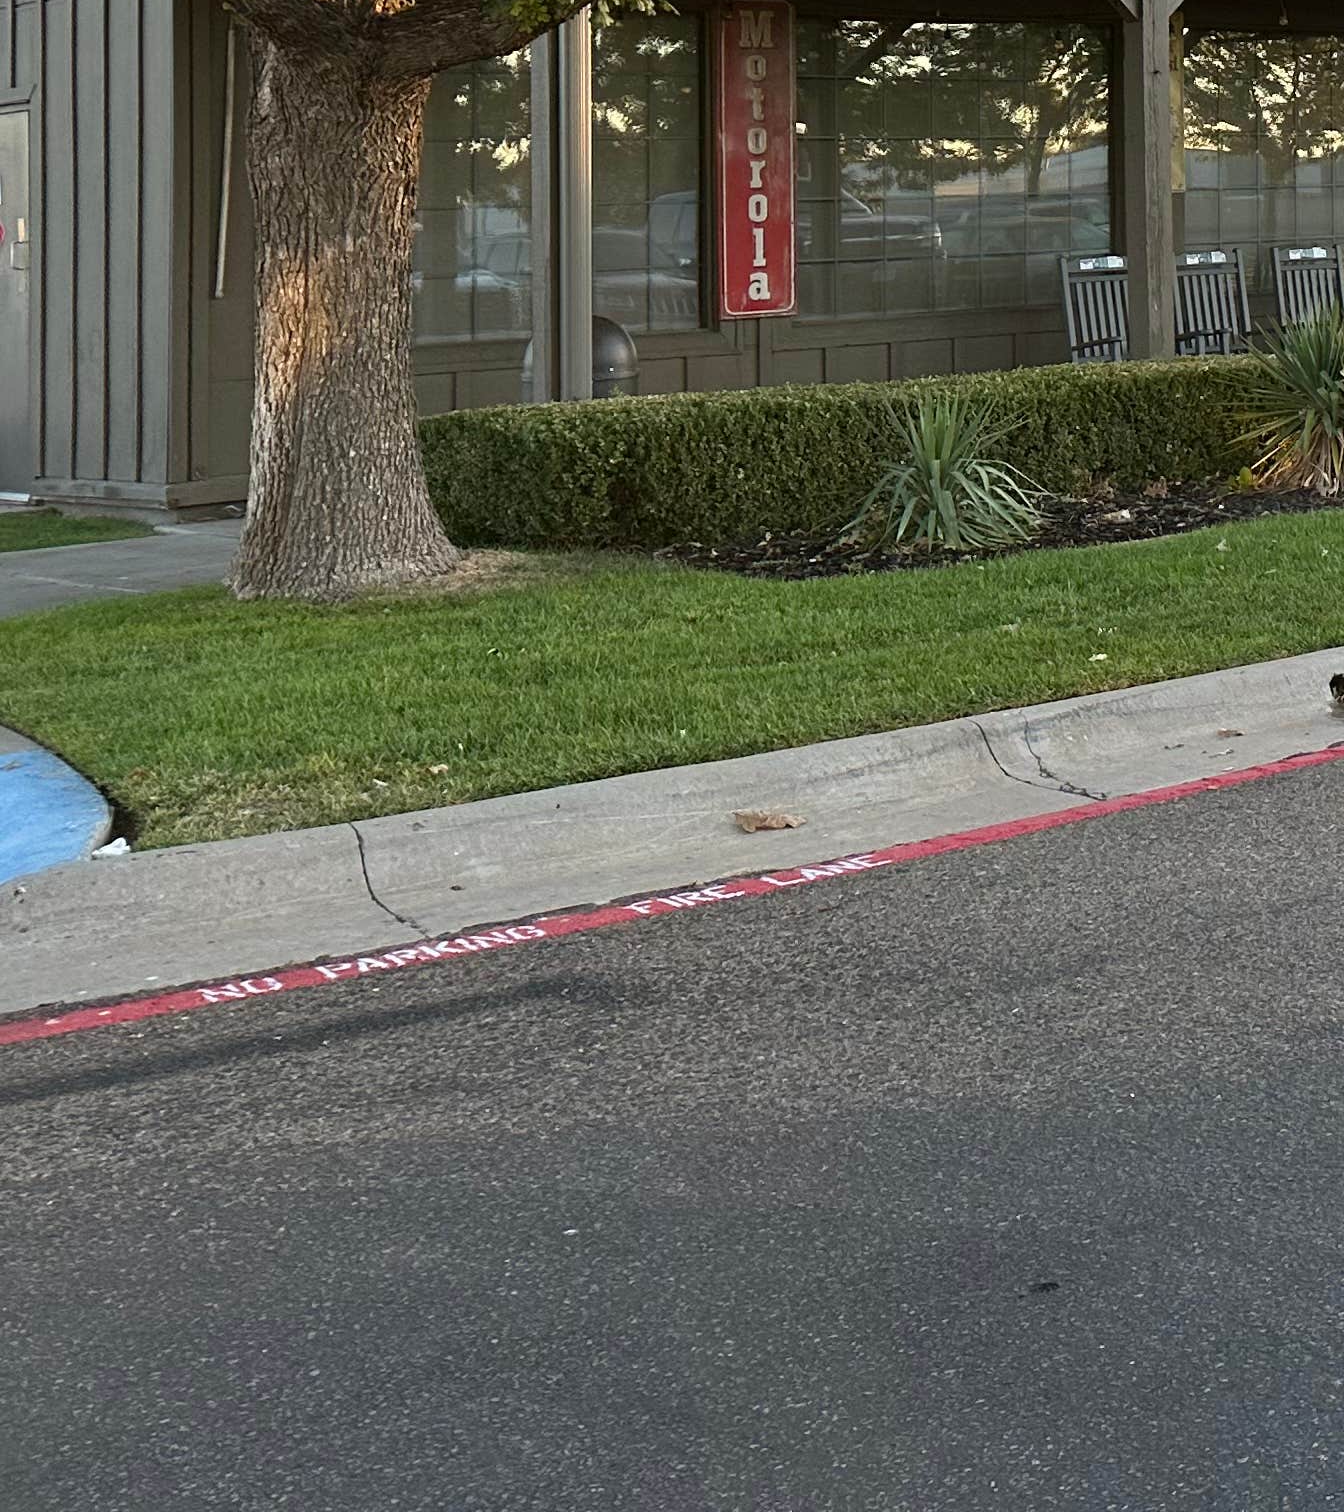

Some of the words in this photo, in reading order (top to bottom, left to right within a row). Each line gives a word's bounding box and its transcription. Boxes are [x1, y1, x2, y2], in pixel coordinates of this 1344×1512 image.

[738, 9, 774, 301] Motorola
[197, 976, 283, 1004] NO
[315, 924, 546, 980] PARKING
[624, 884, 746, 915] FIRE
[760, 854, 892, 887] LANE
